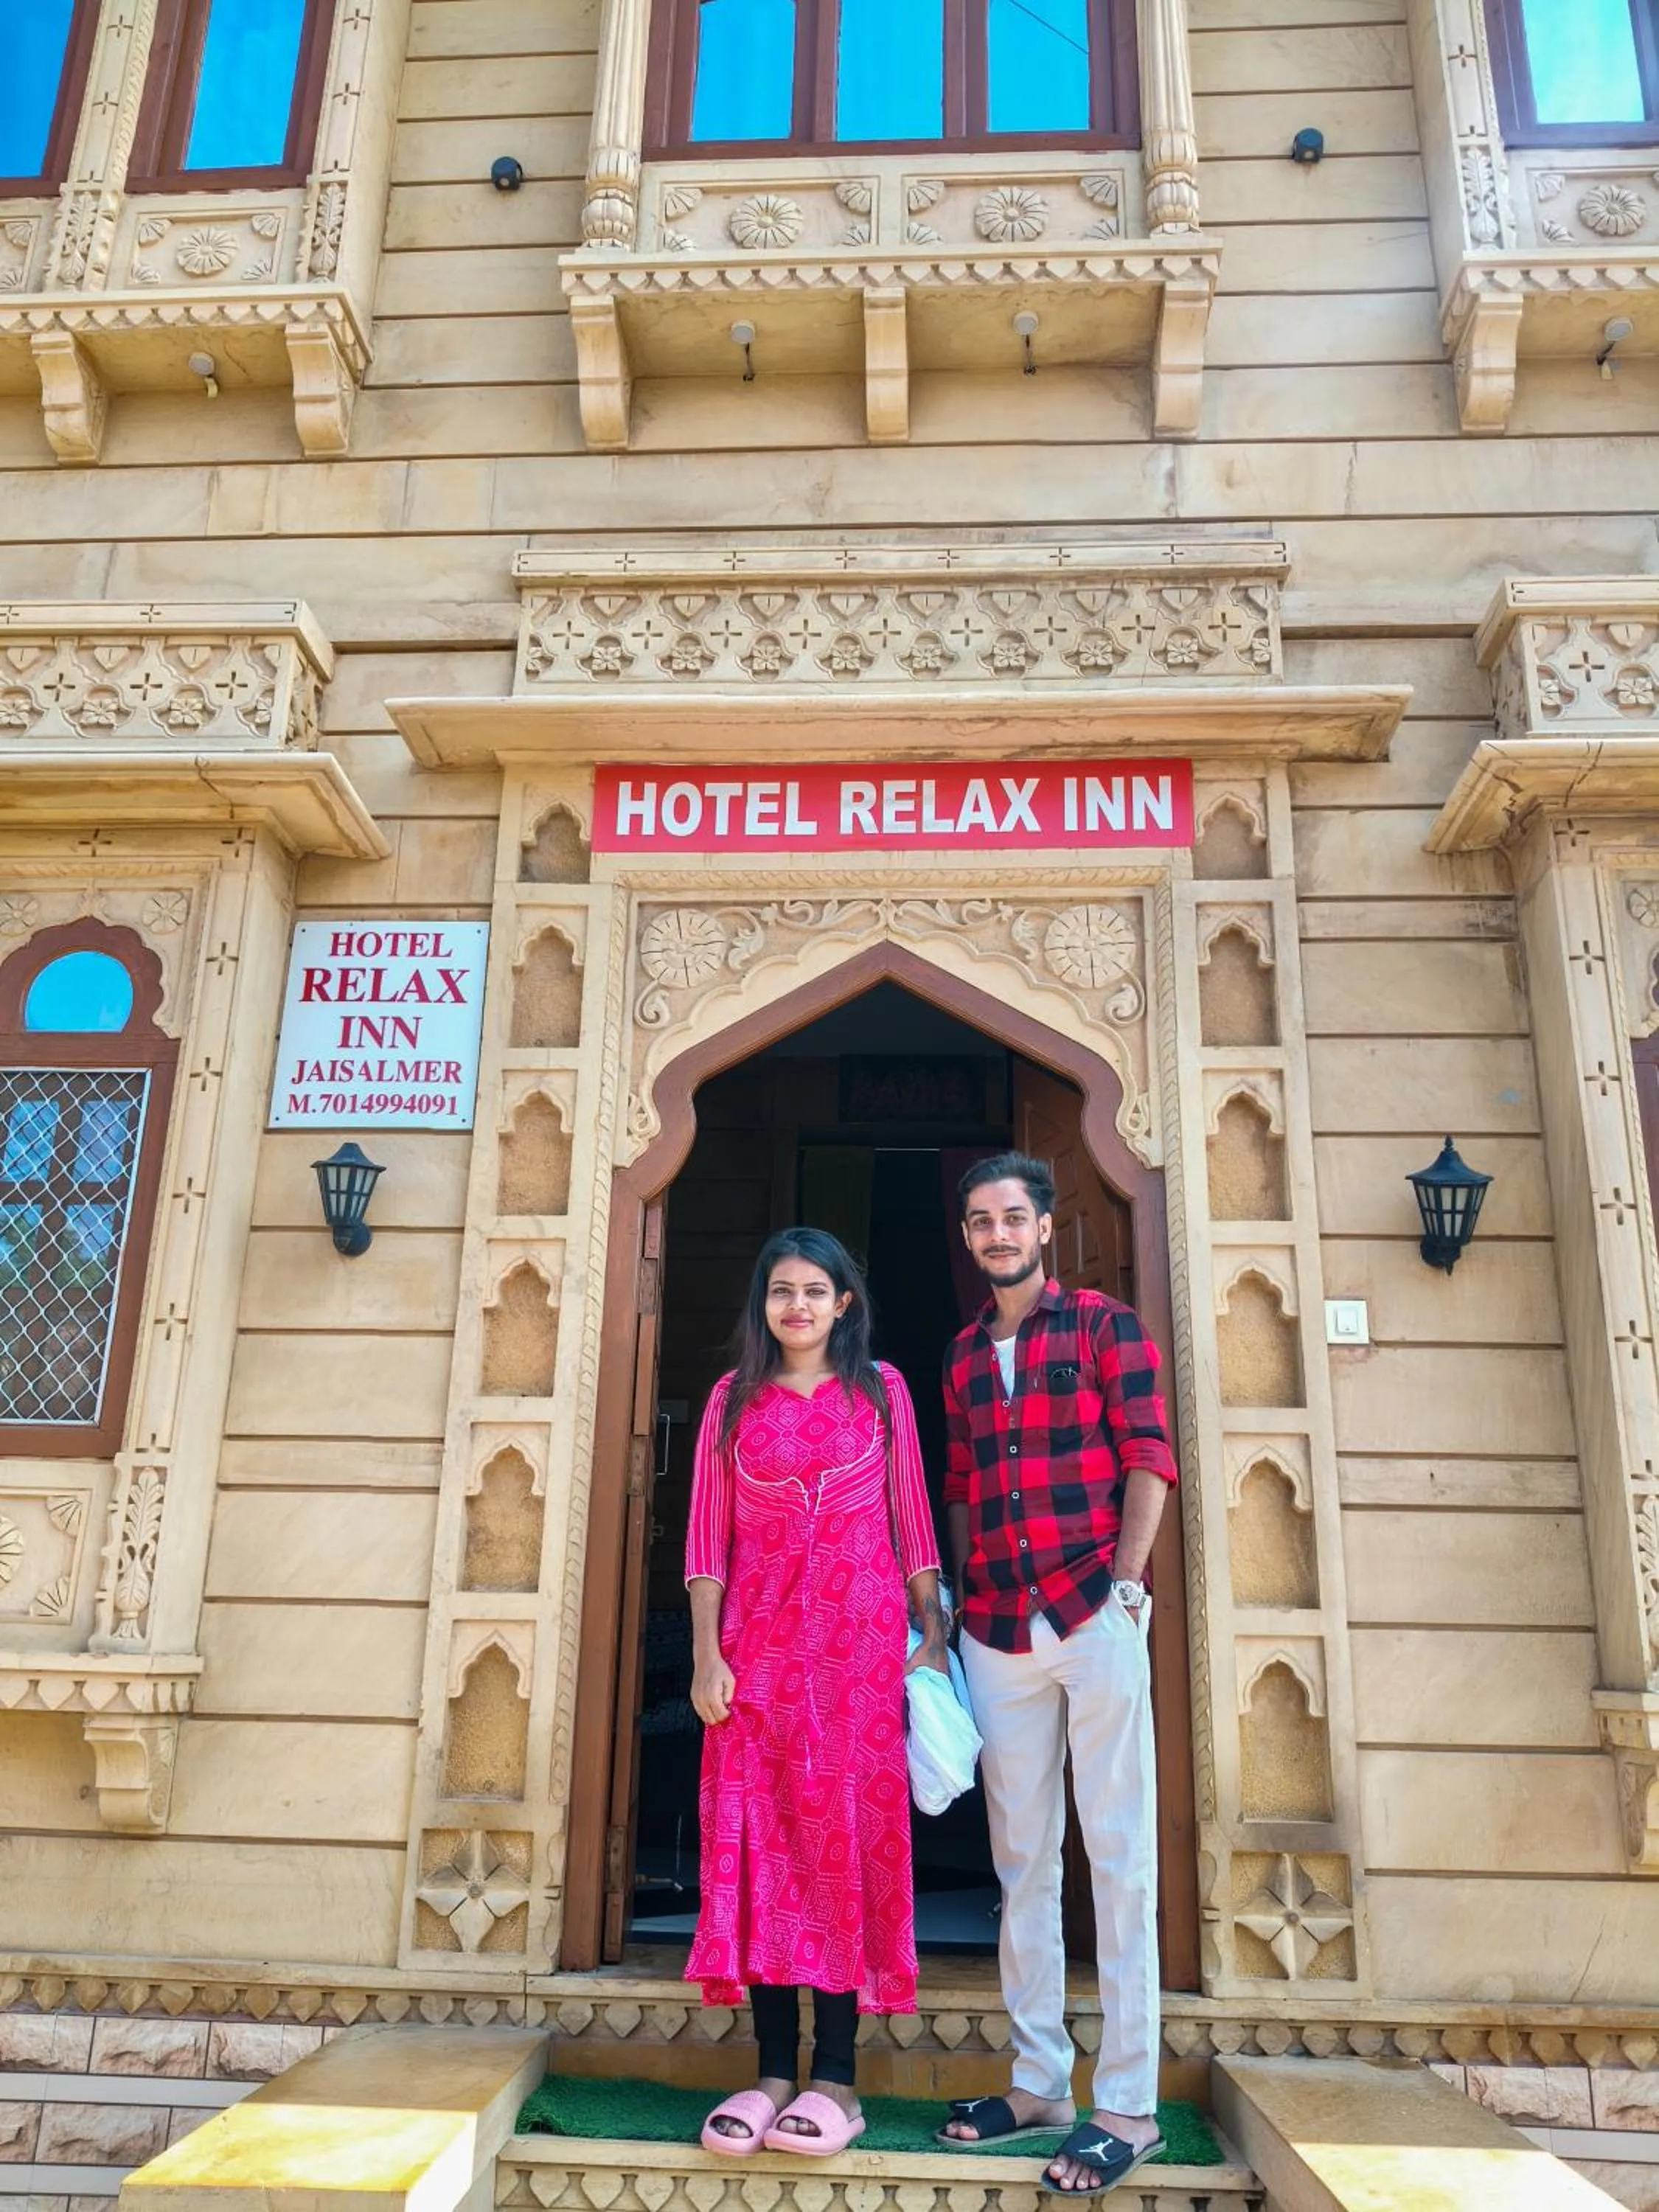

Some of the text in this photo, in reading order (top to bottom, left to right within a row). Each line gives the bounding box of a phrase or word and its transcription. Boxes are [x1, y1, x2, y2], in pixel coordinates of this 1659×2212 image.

[616, 776, 1173, 836] HOTEL RELAX INN
[329, 931, 453, 958] HOTEL
[299, 967, 470, 1004] RELAX
[337, 1015, 422, 1049] INN
[291, 1060, 462, 1085] JAISALMER
[288, 1093, 457, 1116] M.7014994091
